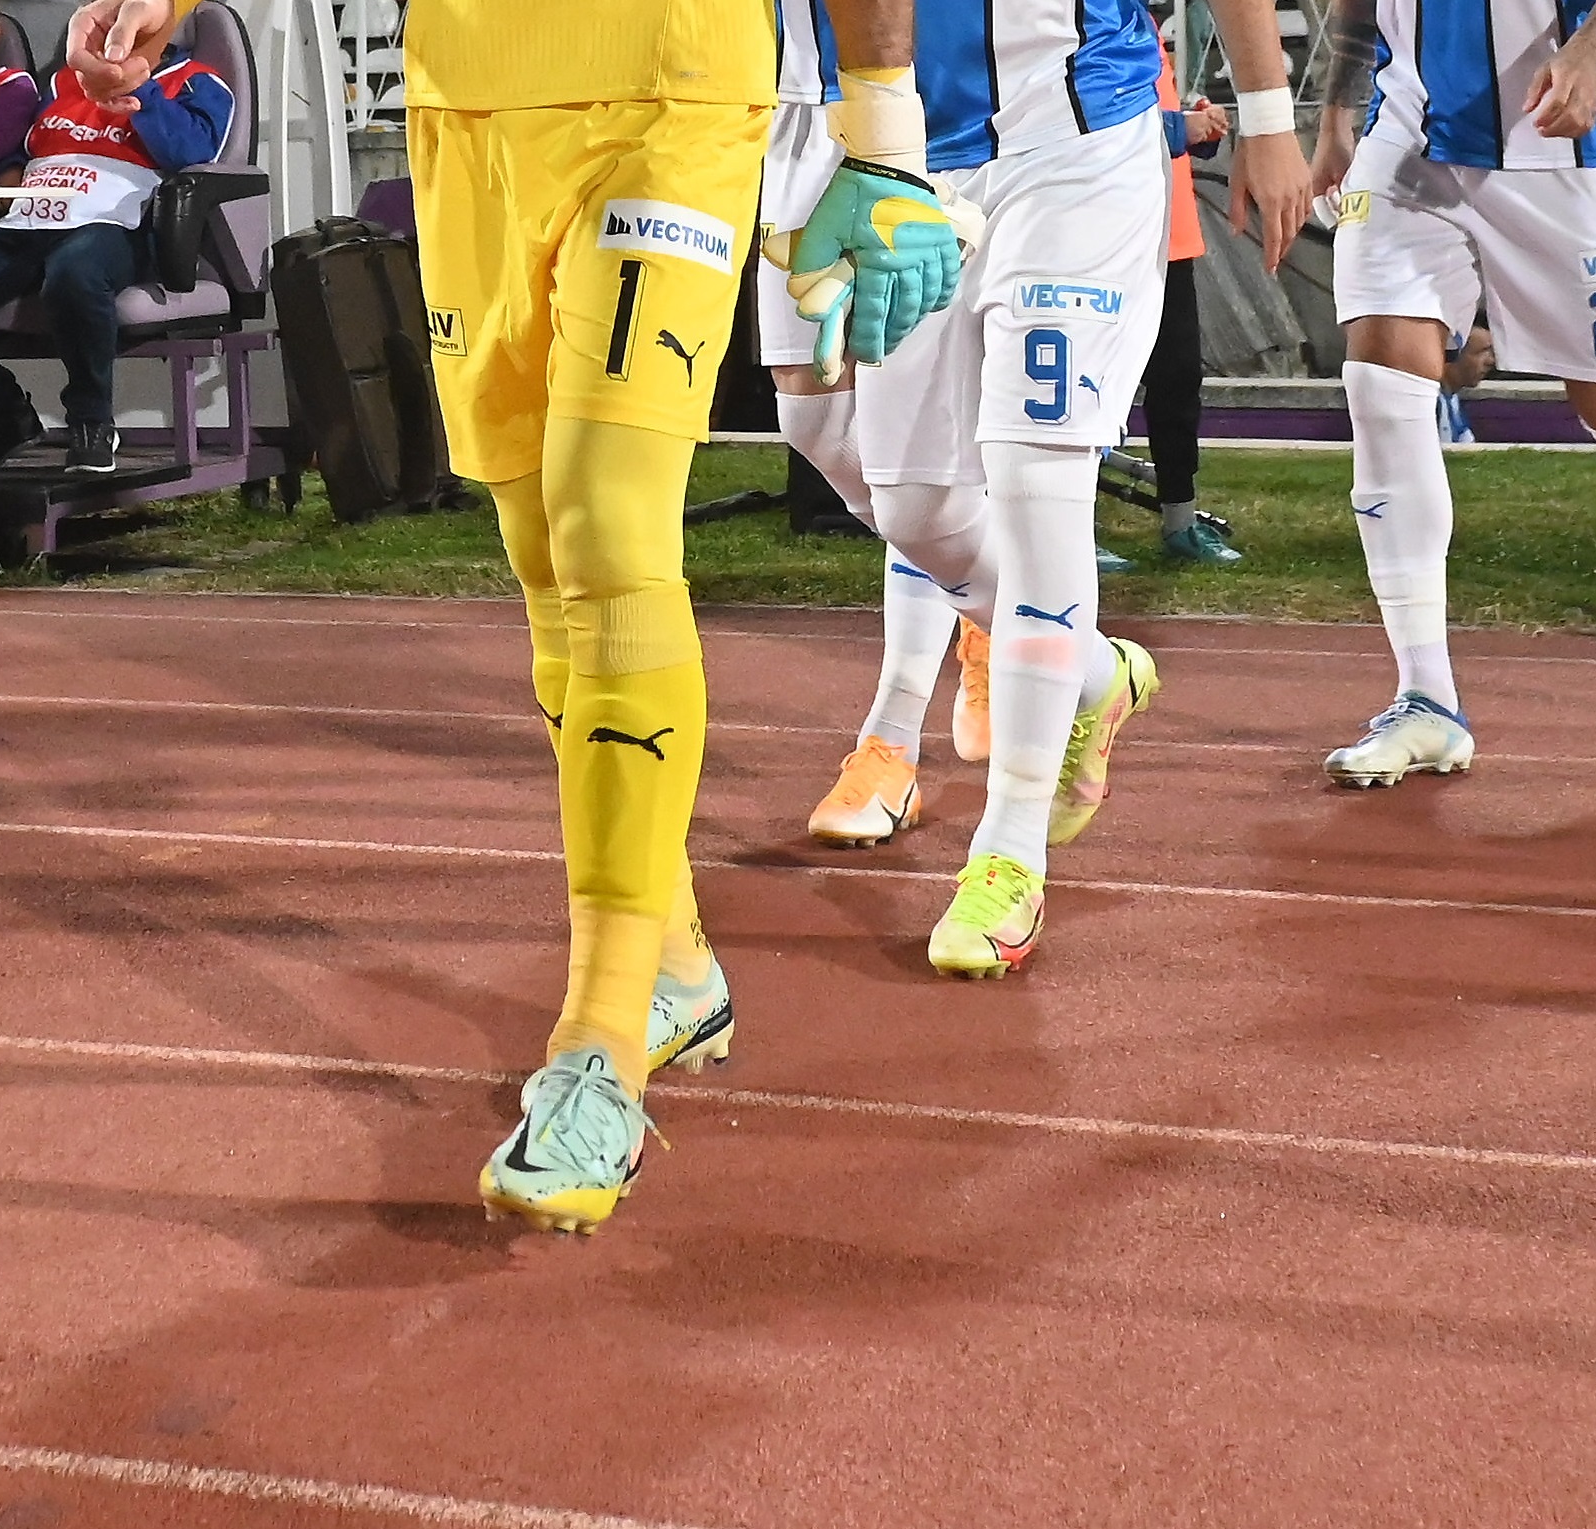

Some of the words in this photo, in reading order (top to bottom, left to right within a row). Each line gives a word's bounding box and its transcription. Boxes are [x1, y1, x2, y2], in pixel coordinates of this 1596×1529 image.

[636, 217, 729, 262] VECTRUM
[605, 259, 648, 383] 1
[1023, 329, 1073, 426] 9
